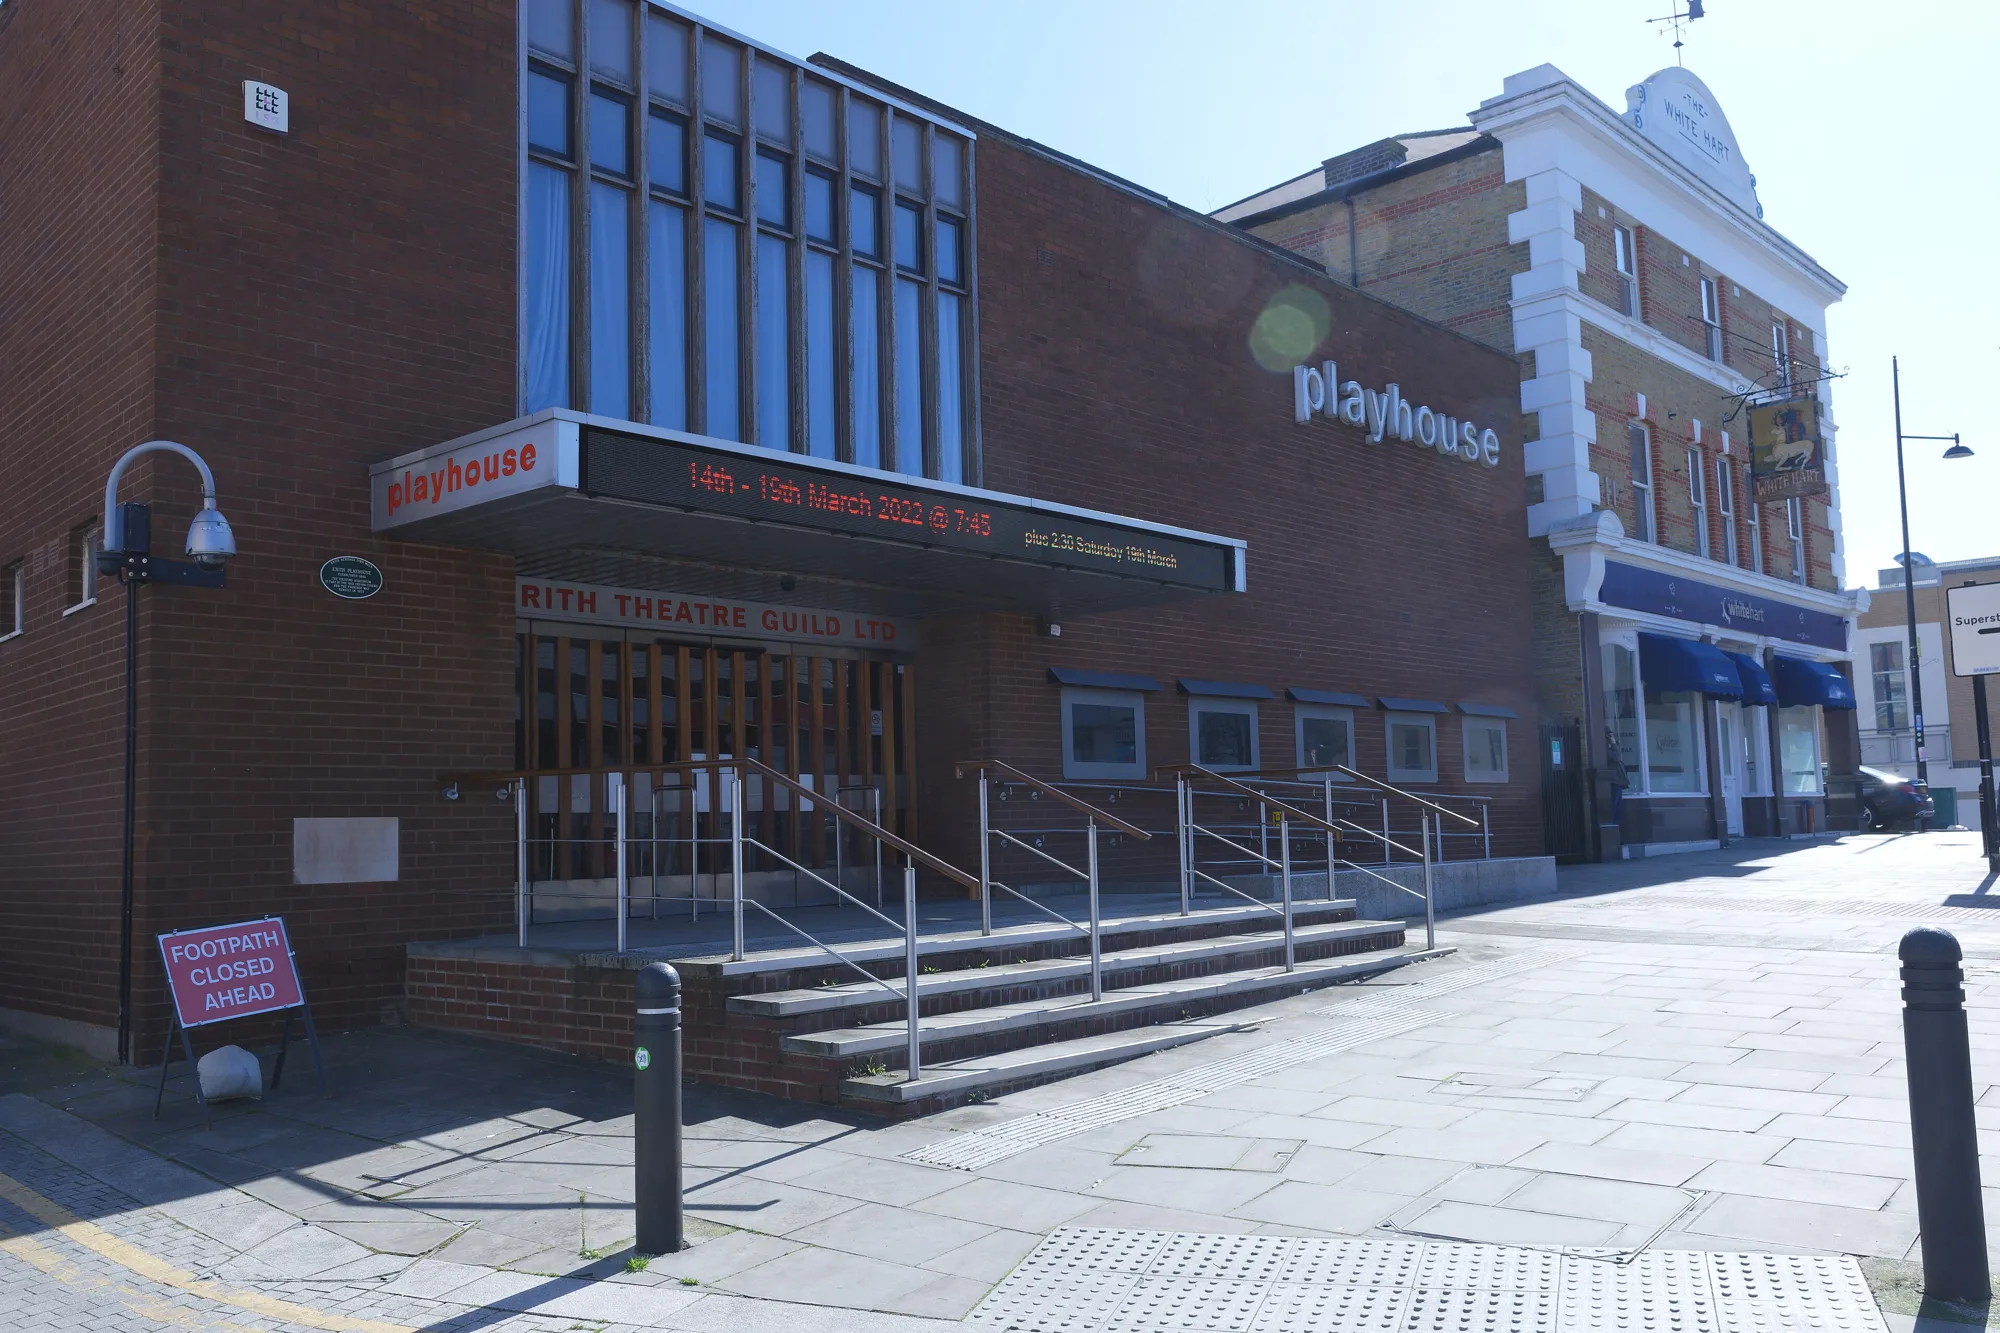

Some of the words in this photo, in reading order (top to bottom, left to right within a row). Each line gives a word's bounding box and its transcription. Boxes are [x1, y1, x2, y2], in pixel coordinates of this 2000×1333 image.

[1663, 98, 1698, 139] WHITE
[1702, 129, 1730, 162] HART
[1293, 359, 1500, 469] playhouse
[387, 442, 538, 516] playhouse
[688, 461, 734, 495] 14th
[758, 474, 802, 506] 19th
[808, 482, 871, 518] March
[878, 495, 923, 526] 2022
[928, 505, 949, 535] @
[954, 509, 992, 537] 7:45
[1756, 474, 1790, 497] WHITE
[1791, 469, 1821, 485] HART
[1025, 529, 1049, 549] plus
[1051, 532, 1075, 551] 2:30
[1076, 536, 1124, 564] Saturday
[1146, 549, 1178, 570] March
[614, 594, 747, 629] THEATRE
[761, 609, 842, 638] GUILD
[854, 619, 897, 641] LTD
[1728, 600, 1765, 623] whitehart
[171, 931, 280, 963] FOOTPATH
[190, 957, 275, 986] CLOSED
[205, 983, 275, 1011] AHEAD
